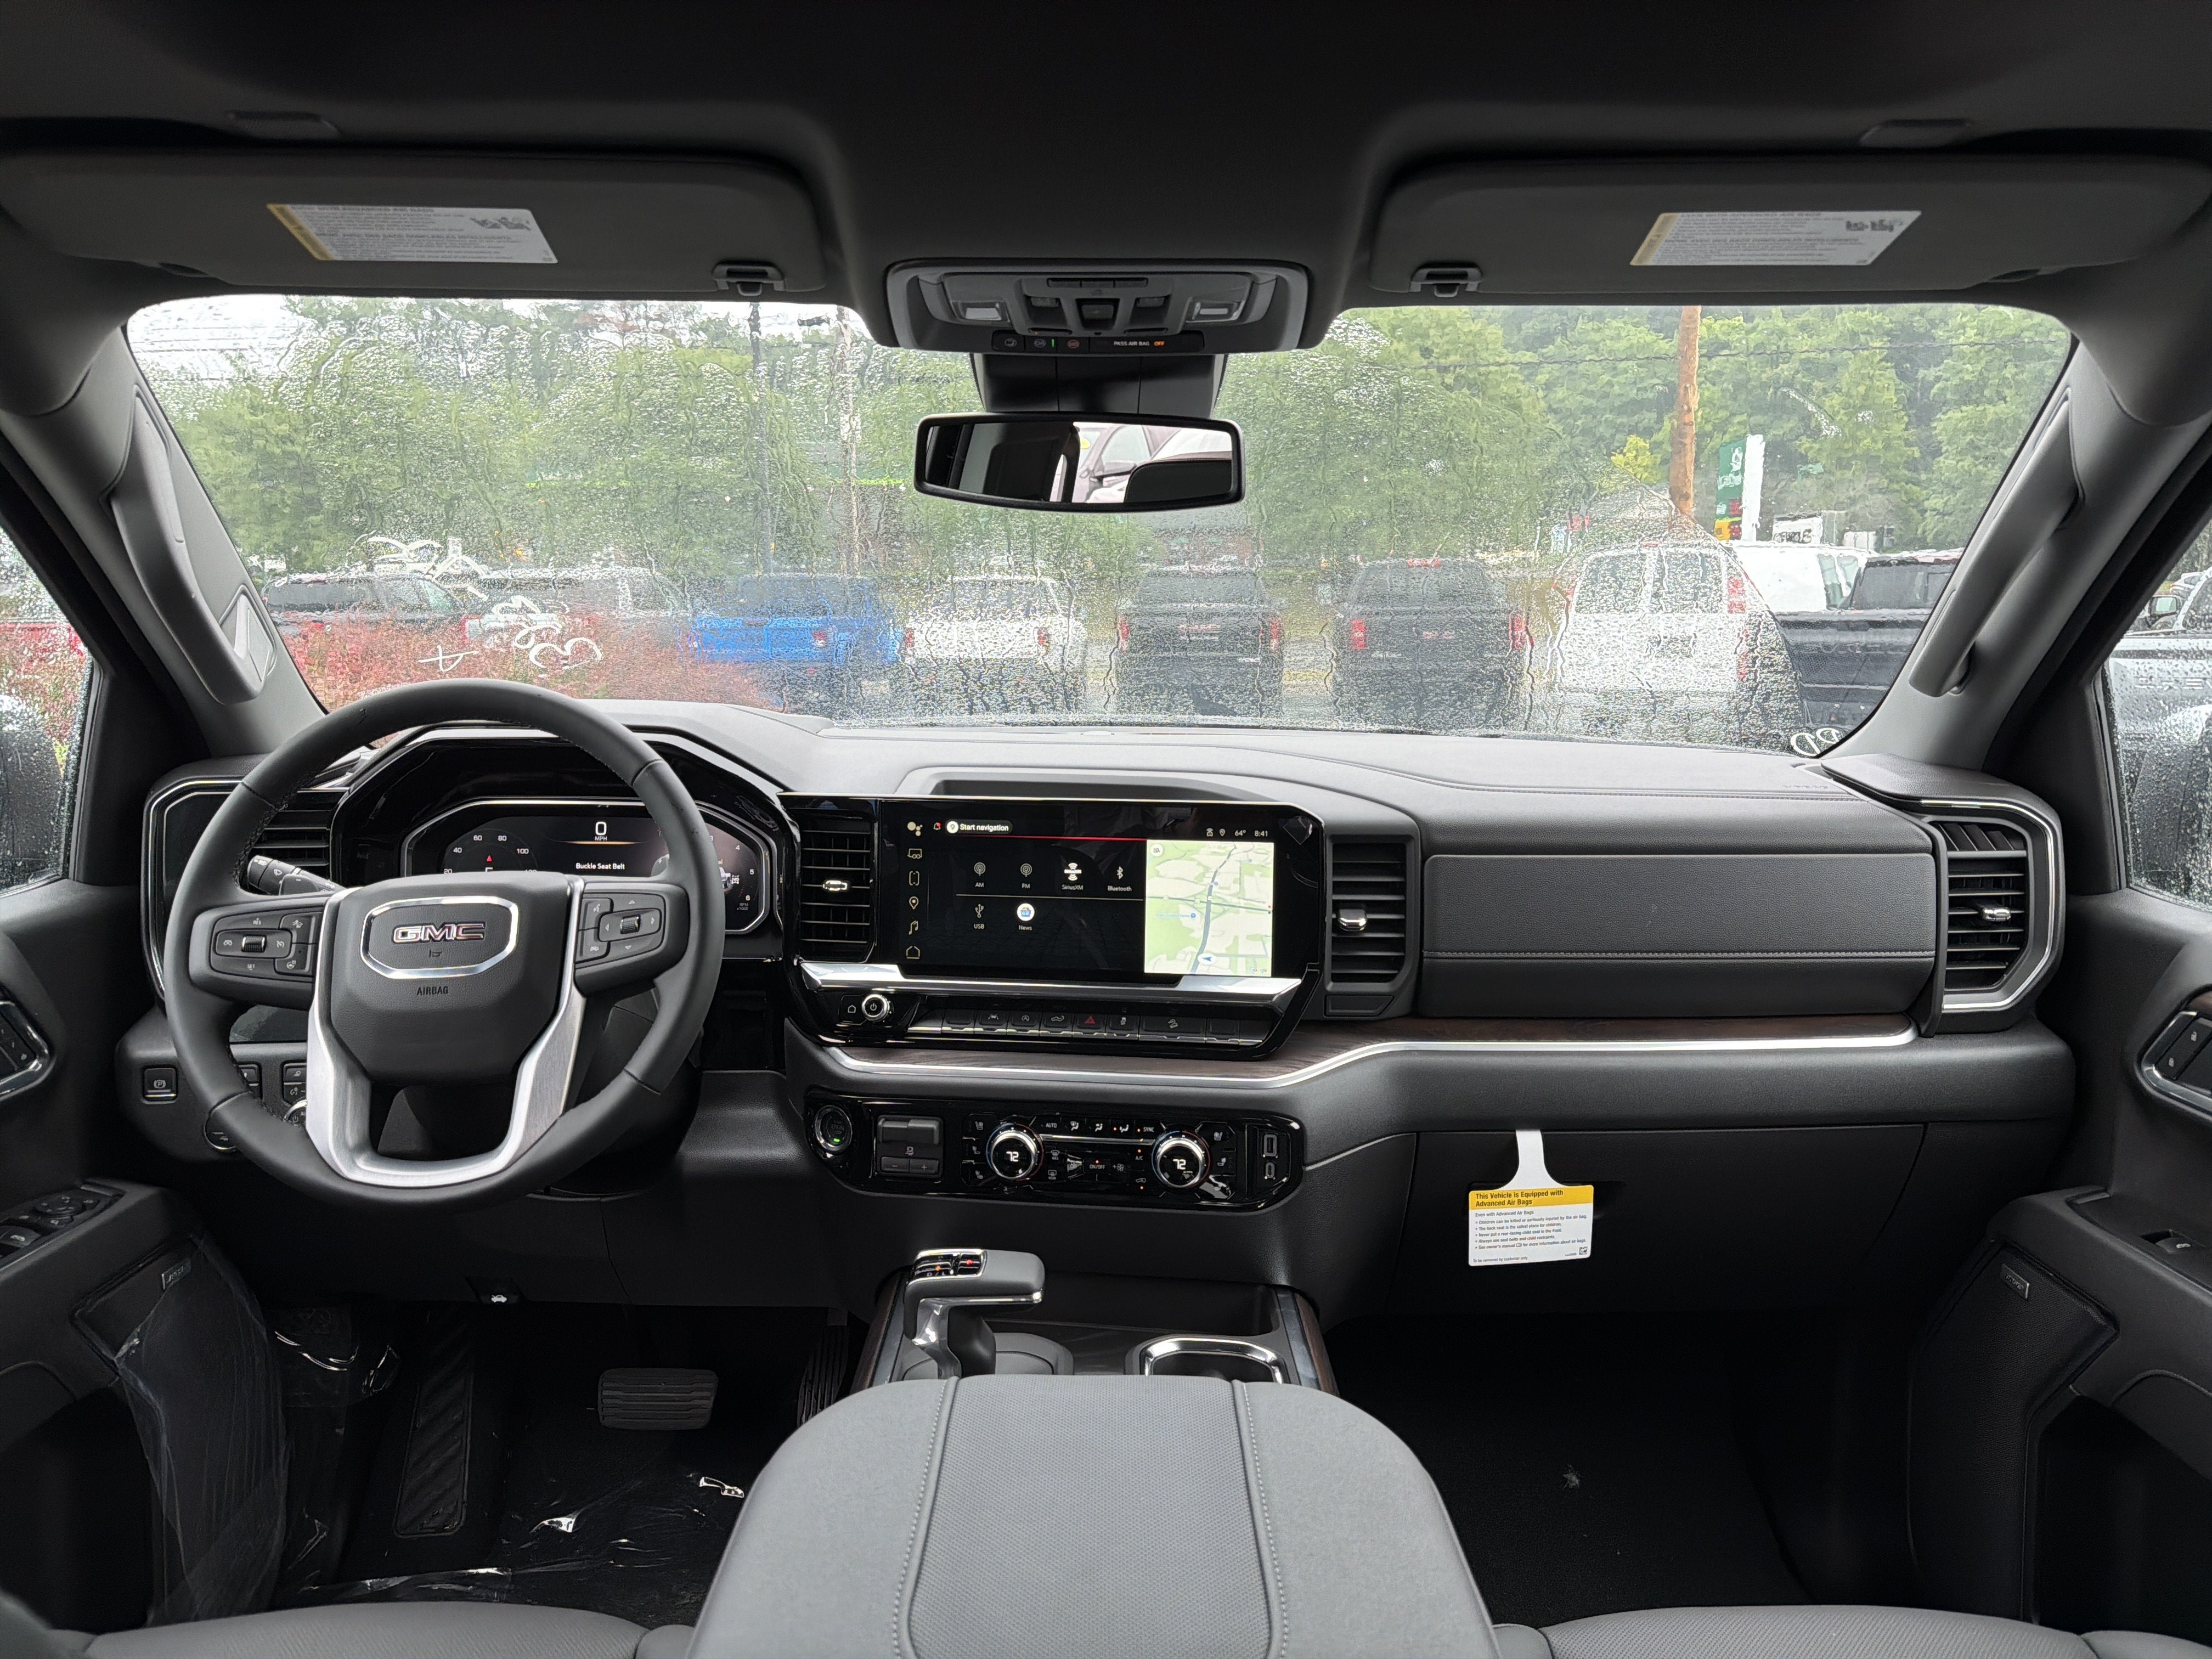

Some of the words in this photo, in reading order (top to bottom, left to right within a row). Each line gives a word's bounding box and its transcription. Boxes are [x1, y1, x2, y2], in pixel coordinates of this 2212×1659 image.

[595, 821, 607, 836] 0
[977, 824, 1009, 832] navigation
[392, 922, 486, 944] GMC
[416, 986, 449, 996] AIRBAG
[1006, 1151, 1019, 1162] 72
[1173, 1159, 1186, 1170] 72
